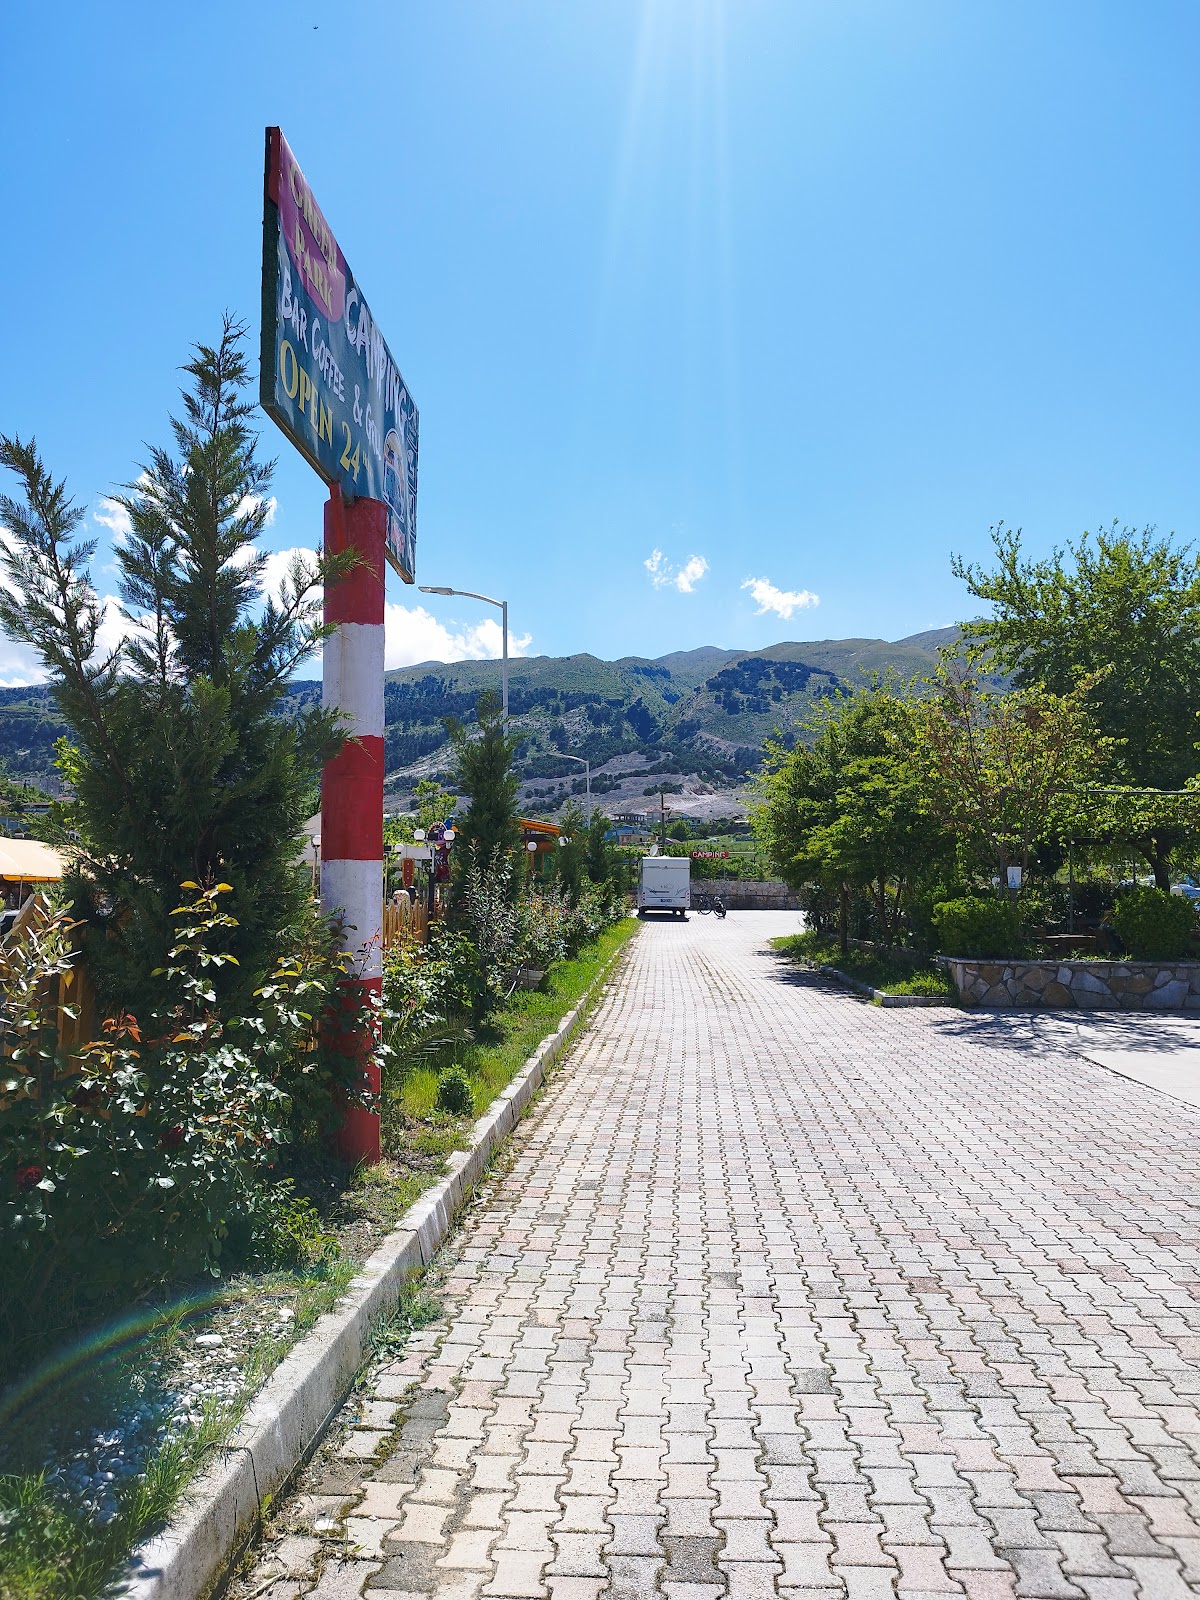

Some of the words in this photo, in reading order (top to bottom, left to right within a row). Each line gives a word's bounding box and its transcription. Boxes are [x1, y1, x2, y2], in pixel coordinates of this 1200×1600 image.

[289, 164, 338, 271] GREEN
[294, 220, 334, 317] PARK
[280, 339, 333, 448] OPEN
[340, 421, 360, 483] 24
[281, 266, 307, 352] BAR
[312, 318, 345, 402] COFFEE
[353, 384, 364, 427] &
[344, 288, 407, 443] CAMPING
